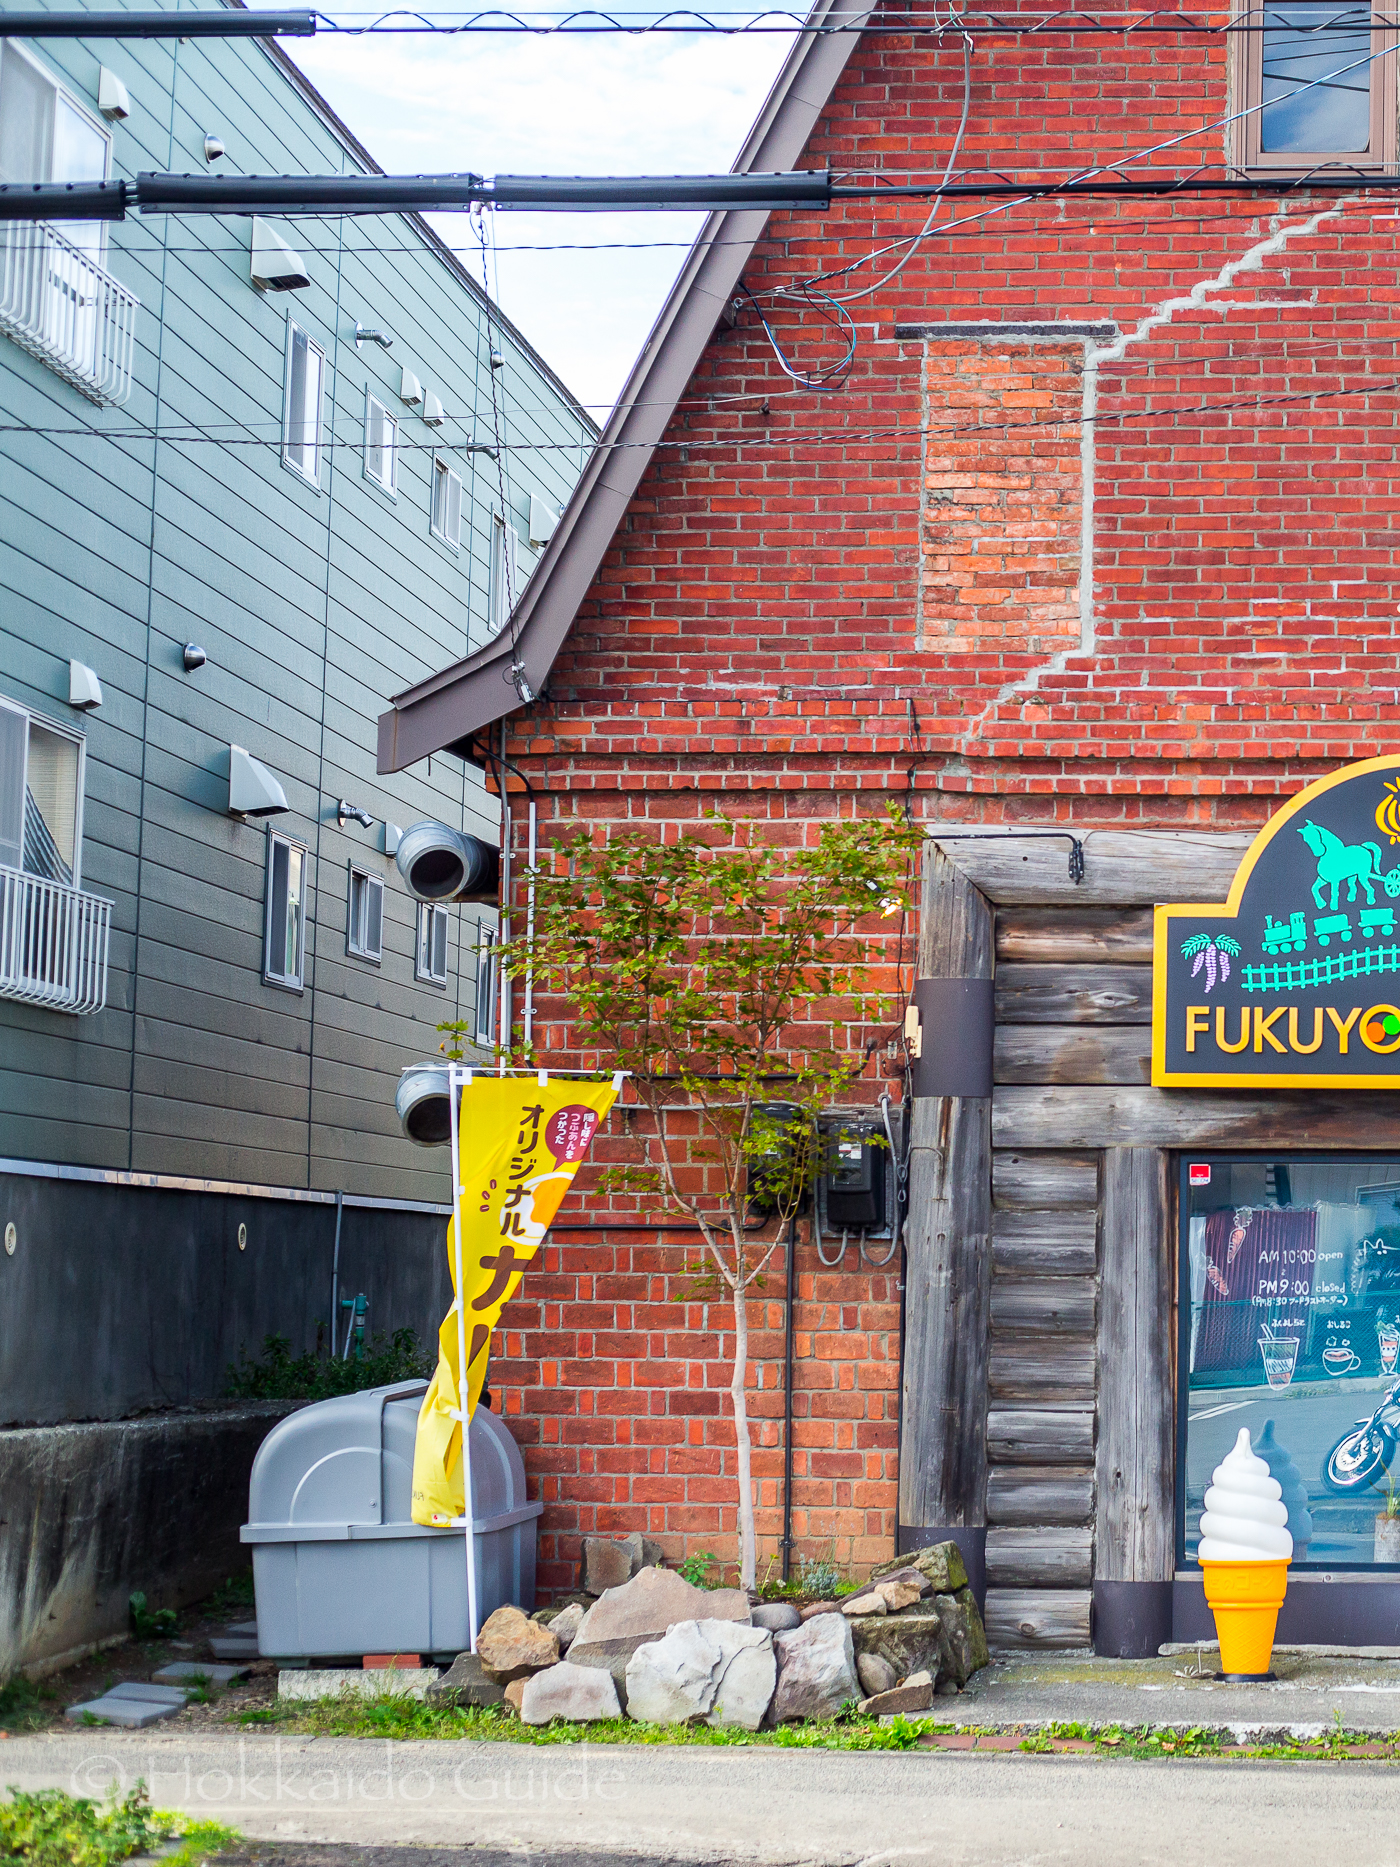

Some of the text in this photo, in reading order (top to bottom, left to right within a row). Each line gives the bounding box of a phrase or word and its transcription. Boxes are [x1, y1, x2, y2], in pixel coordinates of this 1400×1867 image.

[554, 1111, 569, 1145] つかった
[564, 1113, 581, 1160] つぶあんを
[499, 1104, 545, 1236] オリジナル
[1258, 1248, 1344, 1265] AM 10:00 open
[1258, 1278, 1346, 1296] PM 9:00 closed
